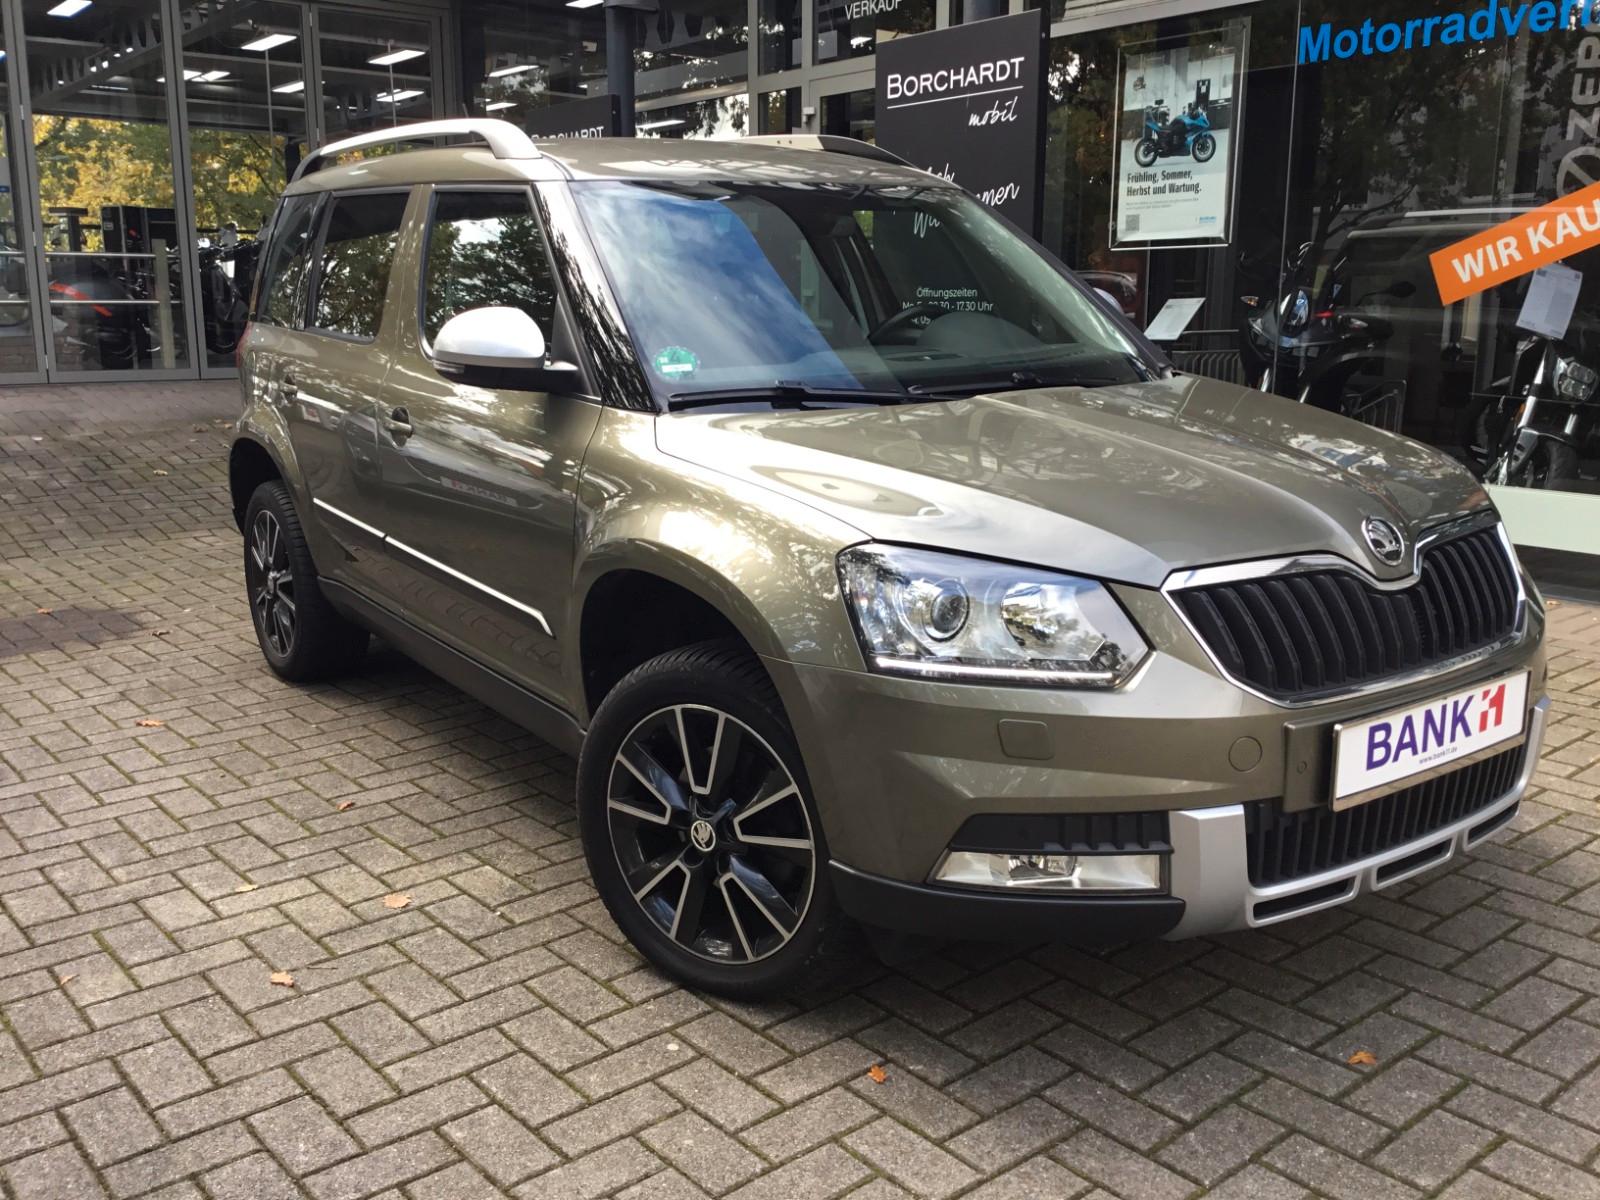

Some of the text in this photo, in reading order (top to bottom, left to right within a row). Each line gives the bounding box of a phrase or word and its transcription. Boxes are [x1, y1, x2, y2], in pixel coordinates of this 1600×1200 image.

[887, 57, 1024, 99] BORCHARDT
[968, 96, 1018, 126] mobil
[1127, 170, 1193, 184] Frühling, Sommer,
[1127, 183, 1201, 196] Herbst und Wartung.
[1451, 198, 1600, 284] WIR KAU
[916, 287, 978, 299] Öffnungszeiten
[977, 302, 994, 311] Uhr
[1366, 694, 1475, 771] BANK
